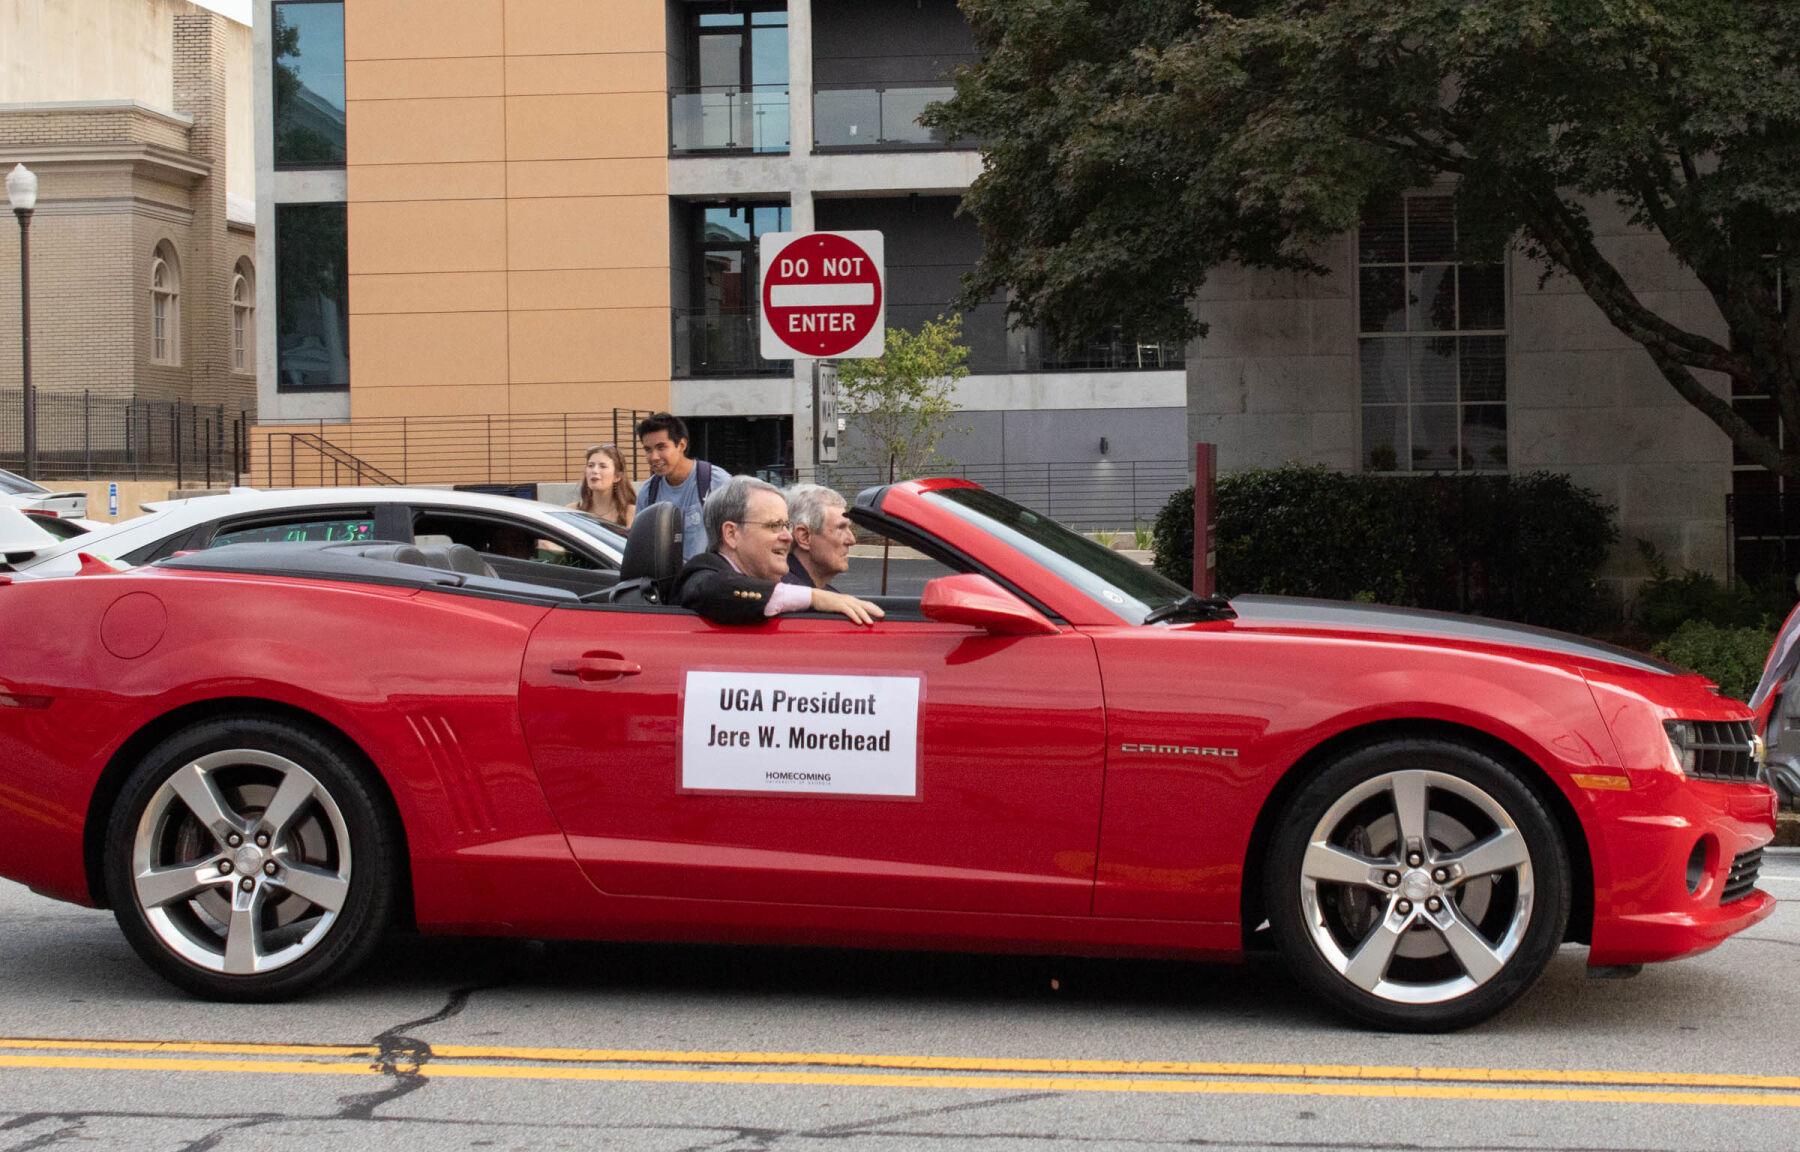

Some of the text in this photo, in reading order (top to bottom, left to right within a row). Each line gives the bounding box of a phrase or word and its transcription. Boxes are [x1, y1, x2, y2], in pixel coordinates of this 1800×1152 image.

[780, 257, 864, 278] DO NOT
[788, 313, 856, 333] ENTER
[822, 373, 836, 396] ONE
[822, 400, 836, 423] WAY
[719, 688, 876, 716] UGA President
[708, 724, 891, 752] Jere W. Morehead
[1121, 743, 1239, 757] CAMARO
[765, 771, 832, 782] HOMECOMING
